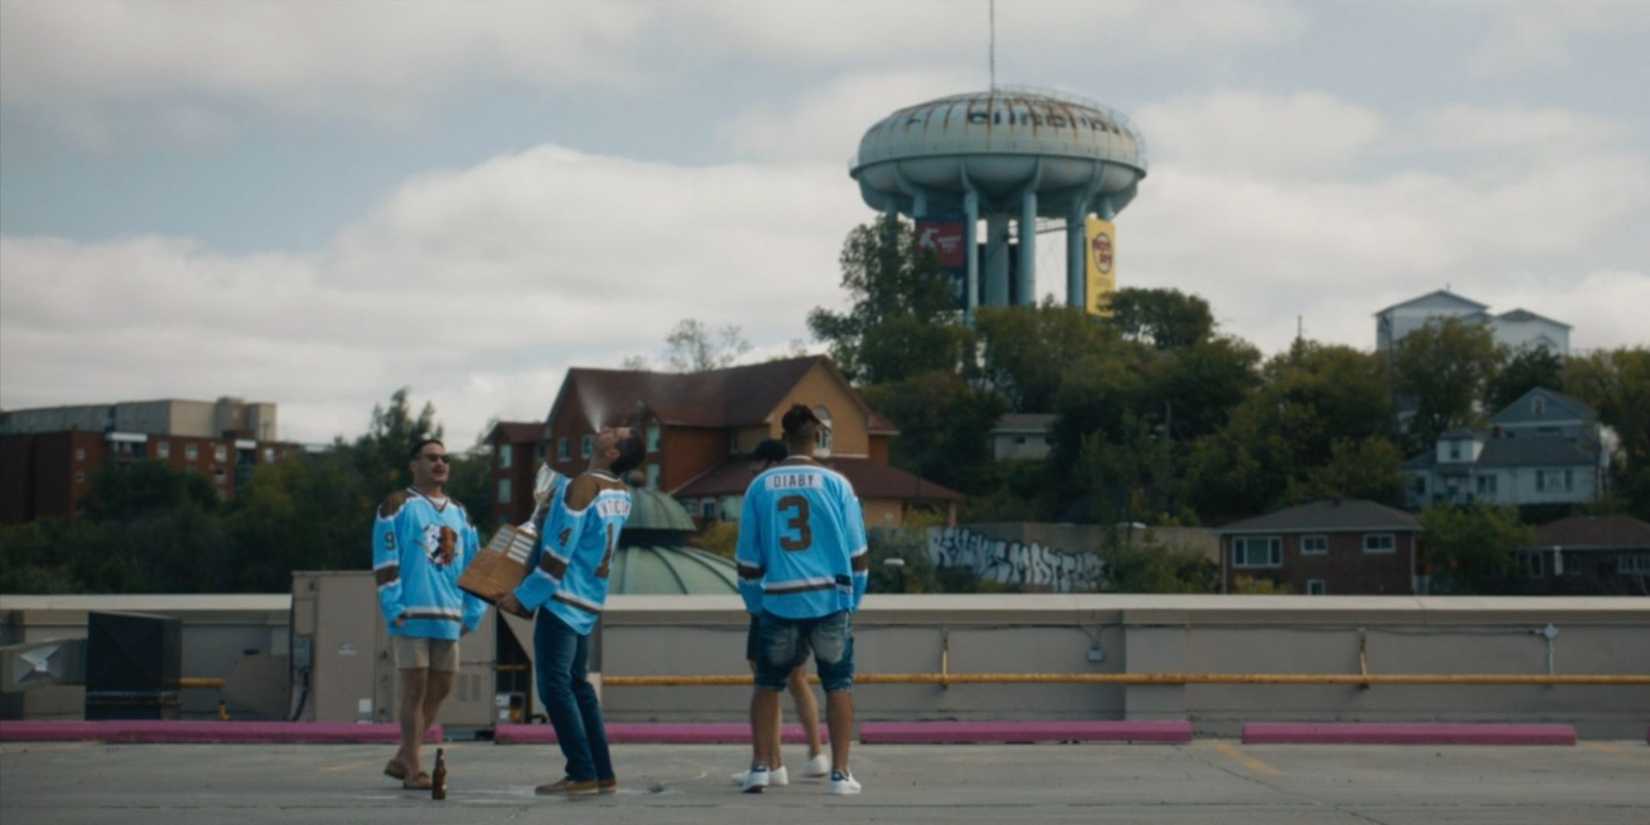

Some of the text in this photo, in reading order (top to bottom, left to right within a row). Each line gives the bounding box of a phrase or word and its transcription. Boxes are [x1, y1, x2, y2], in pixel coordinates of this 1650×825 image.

[774, 475, 813, 488] DIABY
[777, 495, 813, 552] 3
[559, 526, 574, 547] 4
